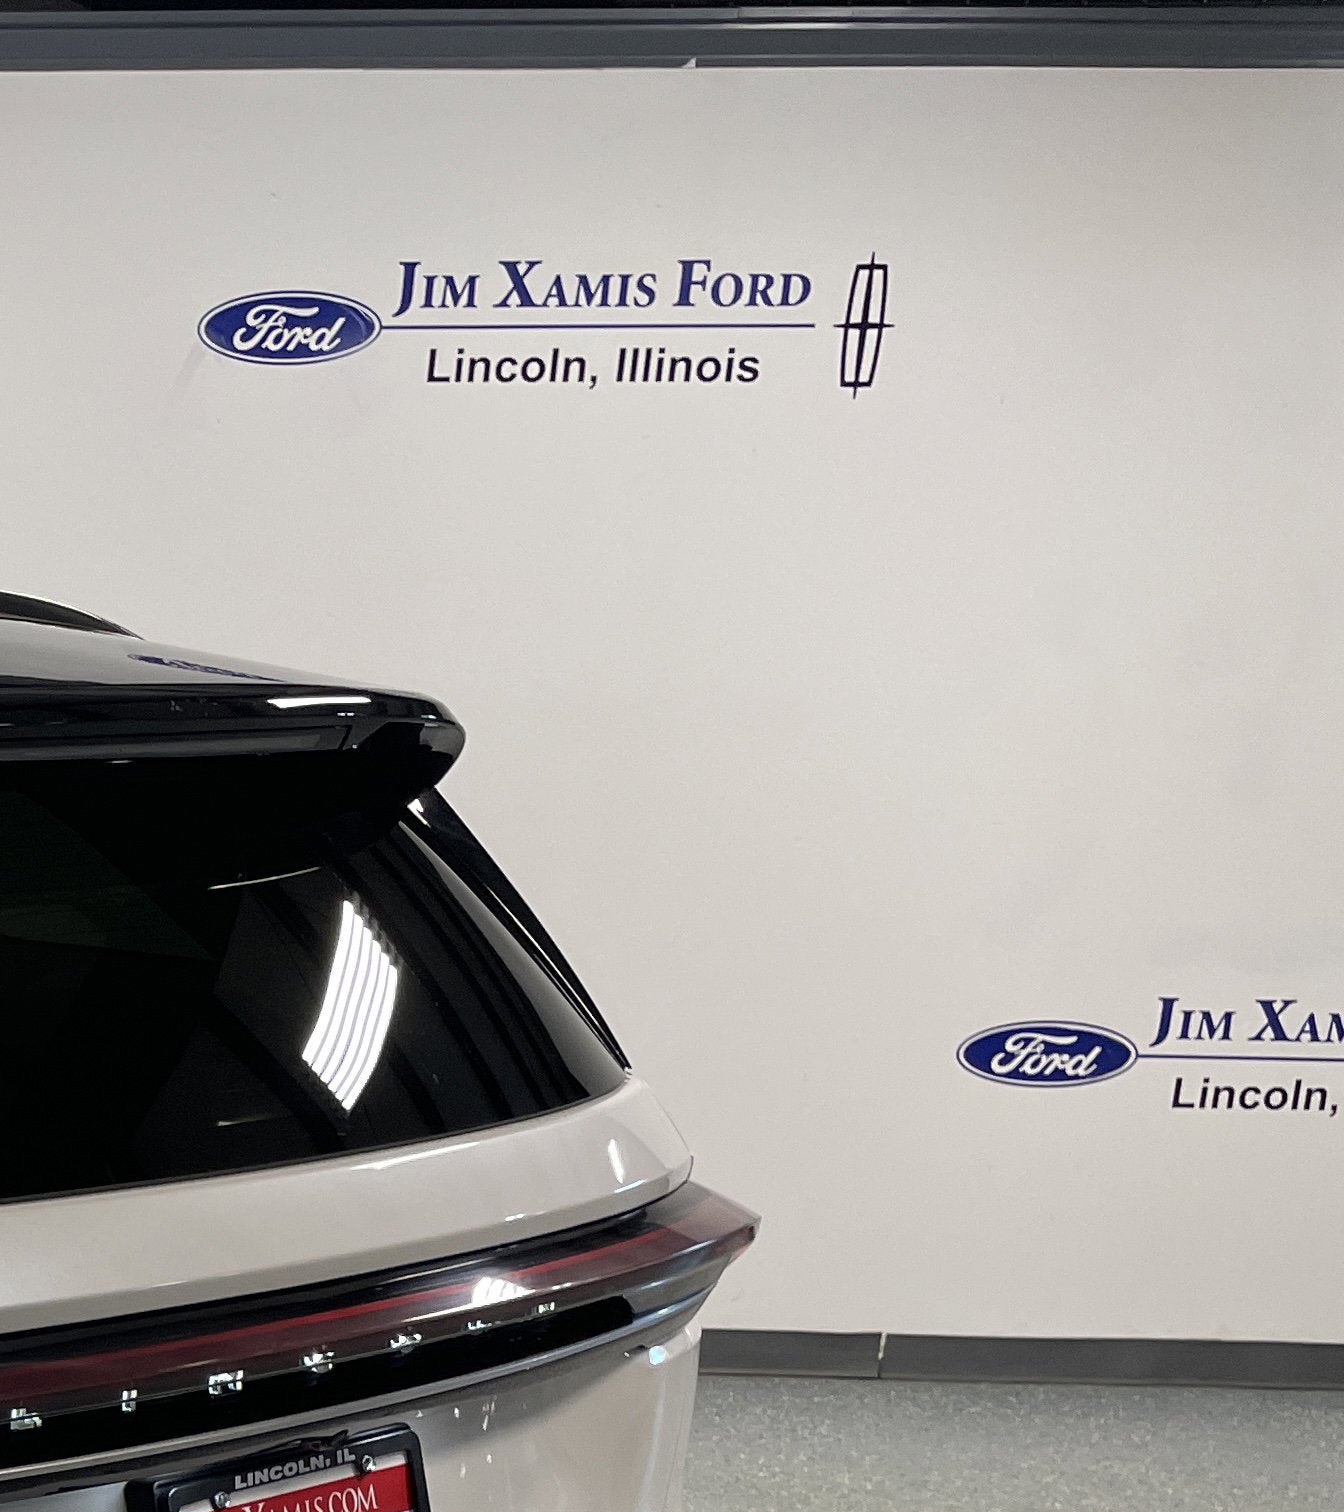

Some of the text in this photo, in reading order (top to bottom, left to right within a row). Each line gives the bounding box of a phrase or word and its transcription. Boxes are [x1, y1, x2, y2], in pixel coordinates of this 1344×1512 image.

[392, 258, 813, 319] JIM XAMIS FORD
[233, 304, 346, 354] Ford
[426, 347, 760, 390] Lincoln, Illinois
[1149, 996, 1236, 1047] JIM
[990, 1031, 1102, 1077] Ford
[1171, 1077, 1339, 1117] Lincoln,
[234, 1448, 356, 1490] LINCOLN, IL
